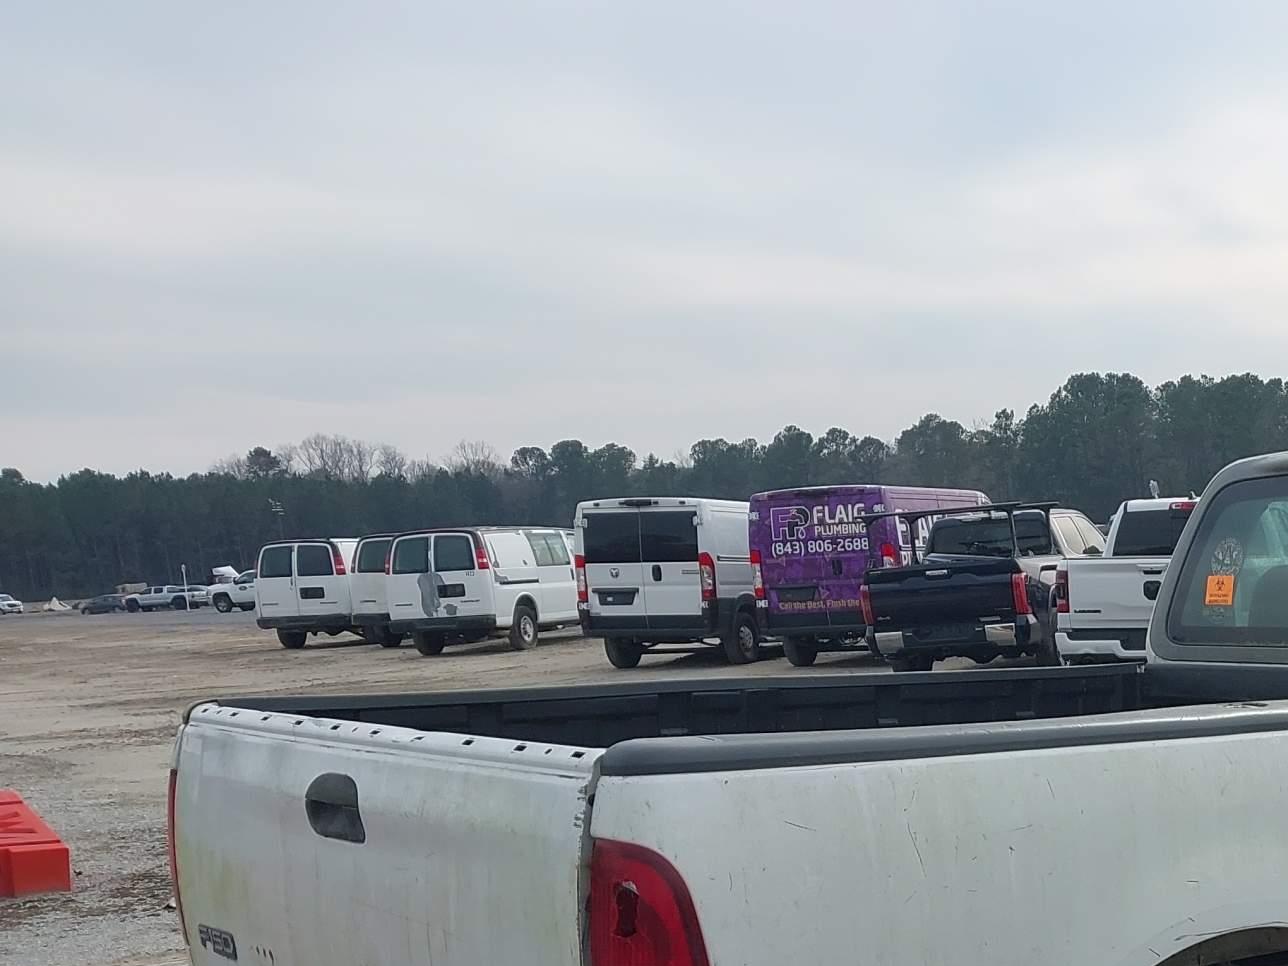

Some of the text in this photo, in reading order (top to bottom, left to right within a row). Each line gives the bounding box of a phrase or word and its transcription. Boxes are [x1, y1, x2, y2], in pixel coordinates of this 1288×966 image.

[813, 522, 867, 538] PLUMBING
[771, 538, 869, 559] (843) 806-2688
